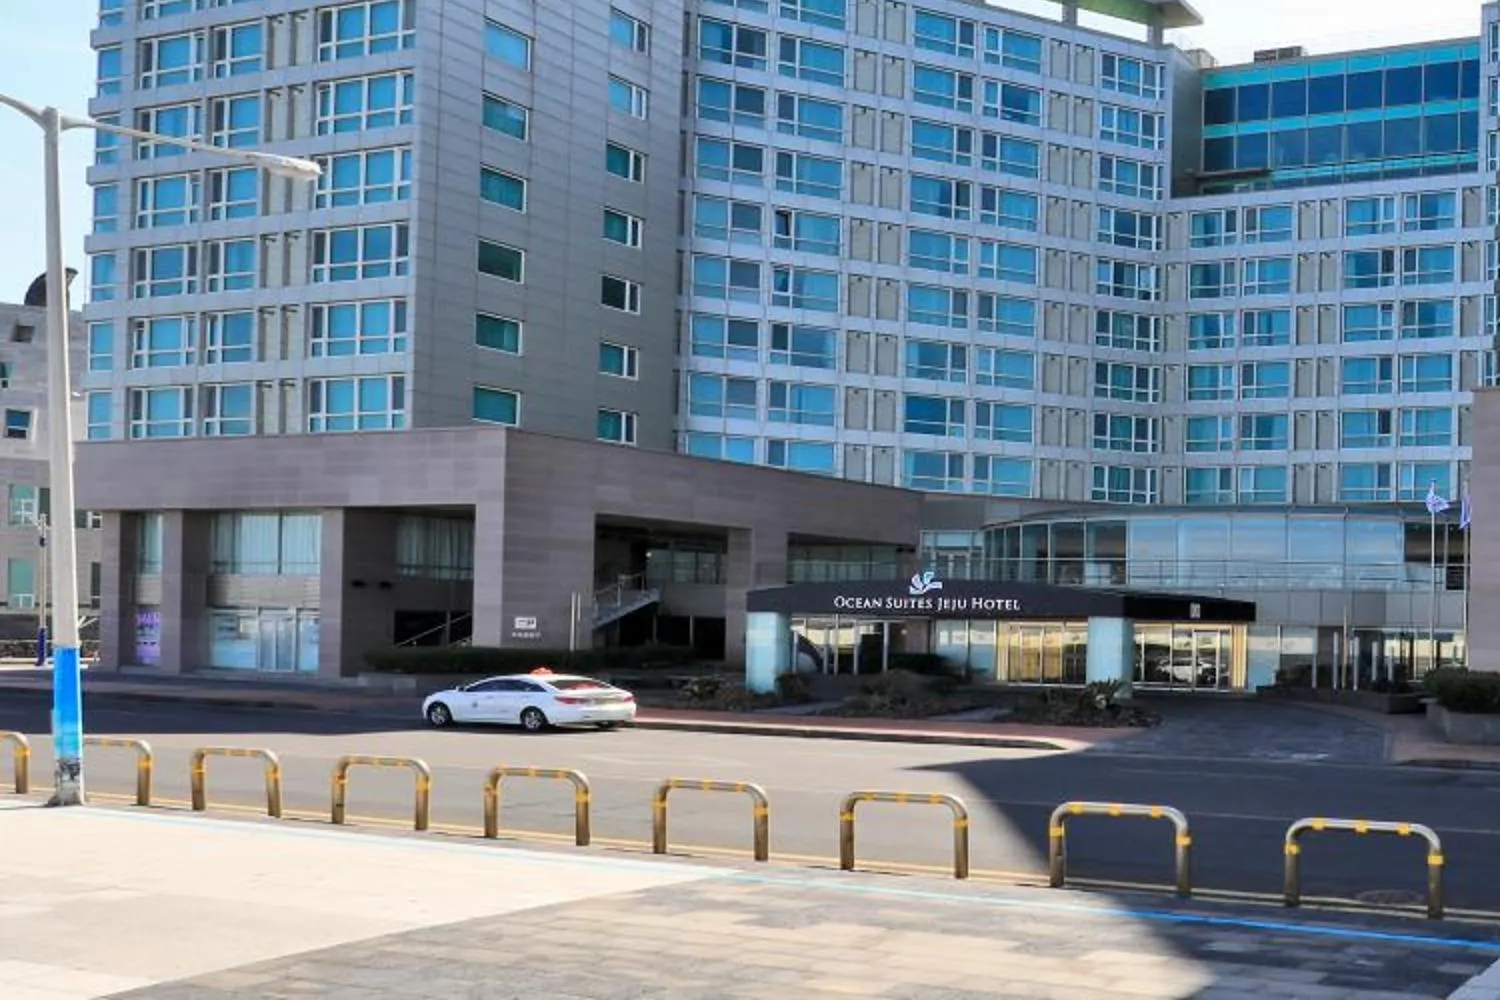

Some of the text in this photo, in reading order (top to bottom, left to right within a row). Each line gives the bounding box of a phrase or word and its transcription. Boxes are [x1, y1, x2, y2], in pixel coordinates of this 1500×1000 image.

[833, 595, 1021, 611] OCEAN SUITES JEJU HOTEL
